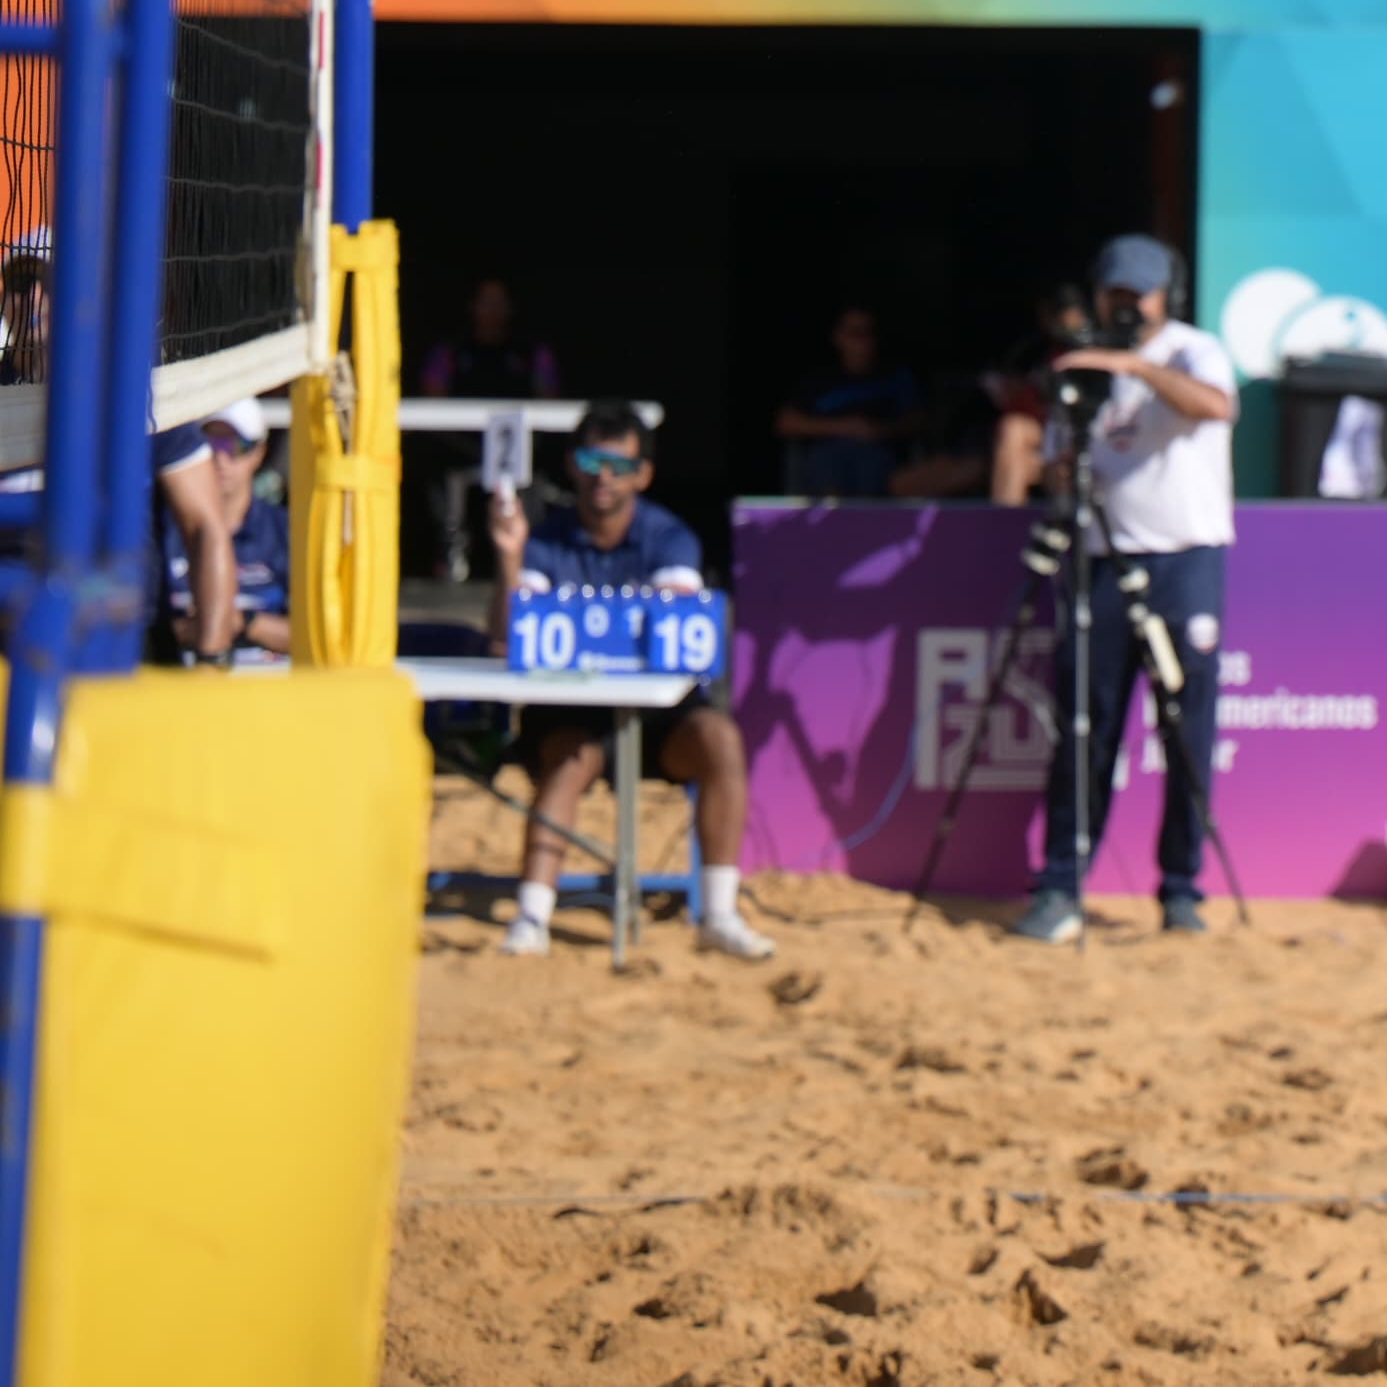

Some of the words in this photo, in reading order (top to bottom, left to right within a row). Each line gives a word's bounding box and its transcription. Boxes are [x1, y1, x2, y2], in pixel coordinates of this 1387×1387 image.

[513, 612, 575, 671] 10
[583, 604, 610, 638] 0
[654, 614, 717, 671] 19
